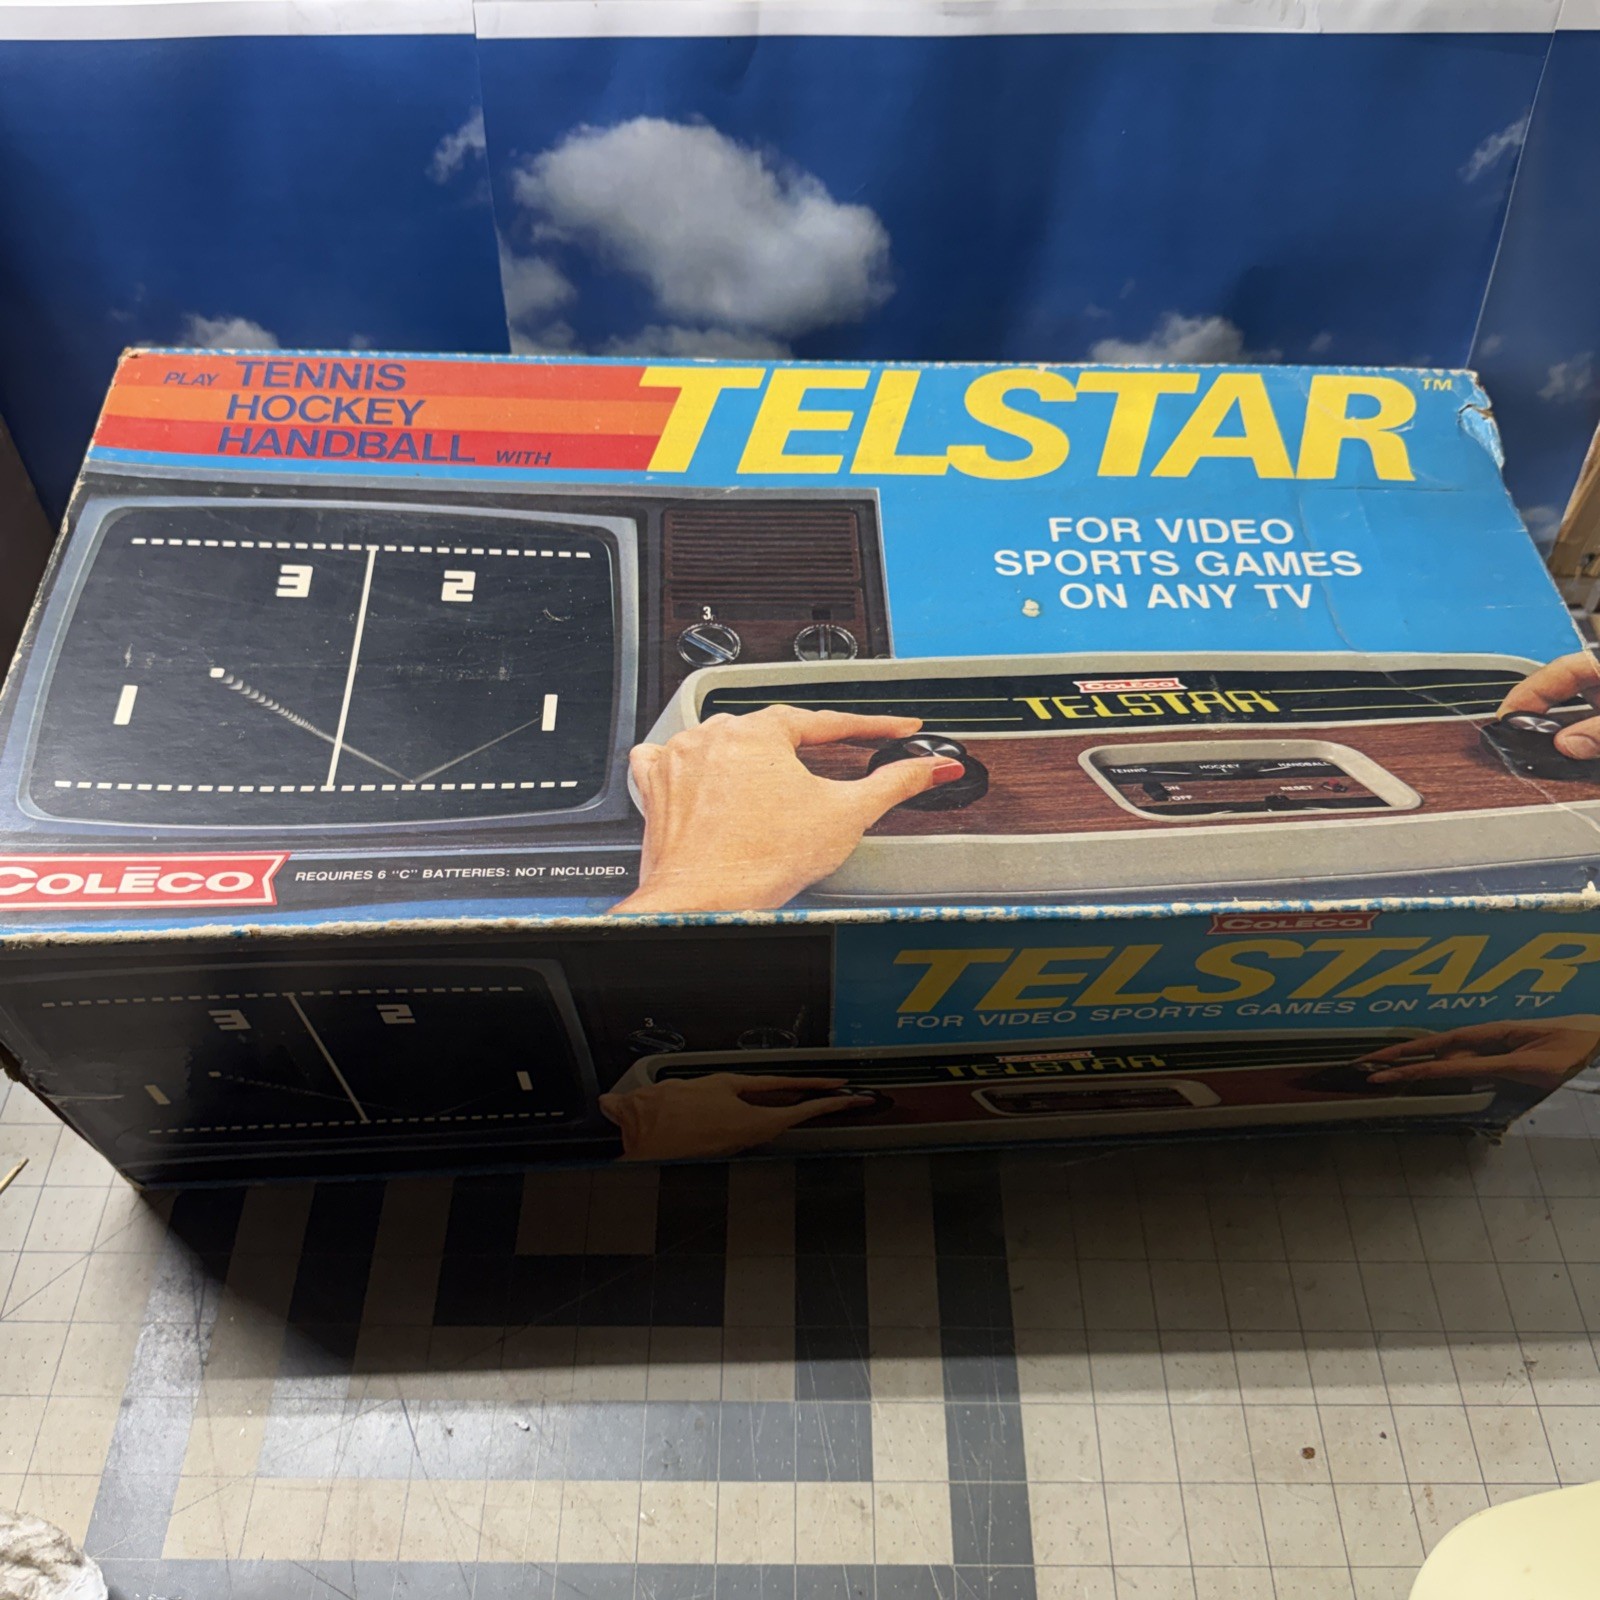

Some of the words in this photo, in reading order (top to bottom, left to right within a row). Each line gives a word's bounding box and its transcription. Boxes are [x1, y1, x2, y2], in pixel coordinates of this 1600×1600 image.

[164, 371, 219, 387] PLAY
[236, 360, 406, 391] TENNIS
[225, 394, 426, 427] HOCKEY
[639, 367, 1417, 481] TELSTAR
[217, 426, 476, 463] HANDBALL
[496, 449, 552, 466] WITH
[1048, 517, 1142, 543] FOR
[1155, 518, 1294, 545] VIDEO
[993, 549, 1180, 577] SPORTS
[1195, 550, 1363, 577] GAMES
[275, 564, 314, 598] 3
[441, 570, 476, 602] 2
[1059, 583, 1128, 610] ON
[1147, 583, 1237, 610] ANY
[1254, 583, 1312, 610] TV
[702, 605, 713, 621] 3
[1014, 690, 1280, 720] TELSTAR
[295, 870, 373, 882] REQUIRES
[377, 870, 386, 880] 6
[422, 867, 510, 879] BATTERIES:
[515, 867, 546, 877] NOT
[551, 866, 629, 876] INCLUDED.
[893, 934, 1600, 1013] TELSTAR
[376, 1004, 416, 1024] 2
[897, 1015, 963, 1029] FOR
[978, 1010, 1077, 1026] VIDEO
[1089, 1003, 1223, 1022] SPORTS
[1235, 1001, 1356, 1017] GAMES
[1368, 998, 1426, 1013] ON
[1427, 995, 1498, 1010] ANY
[1515, 995, 1555, 1008] TV
